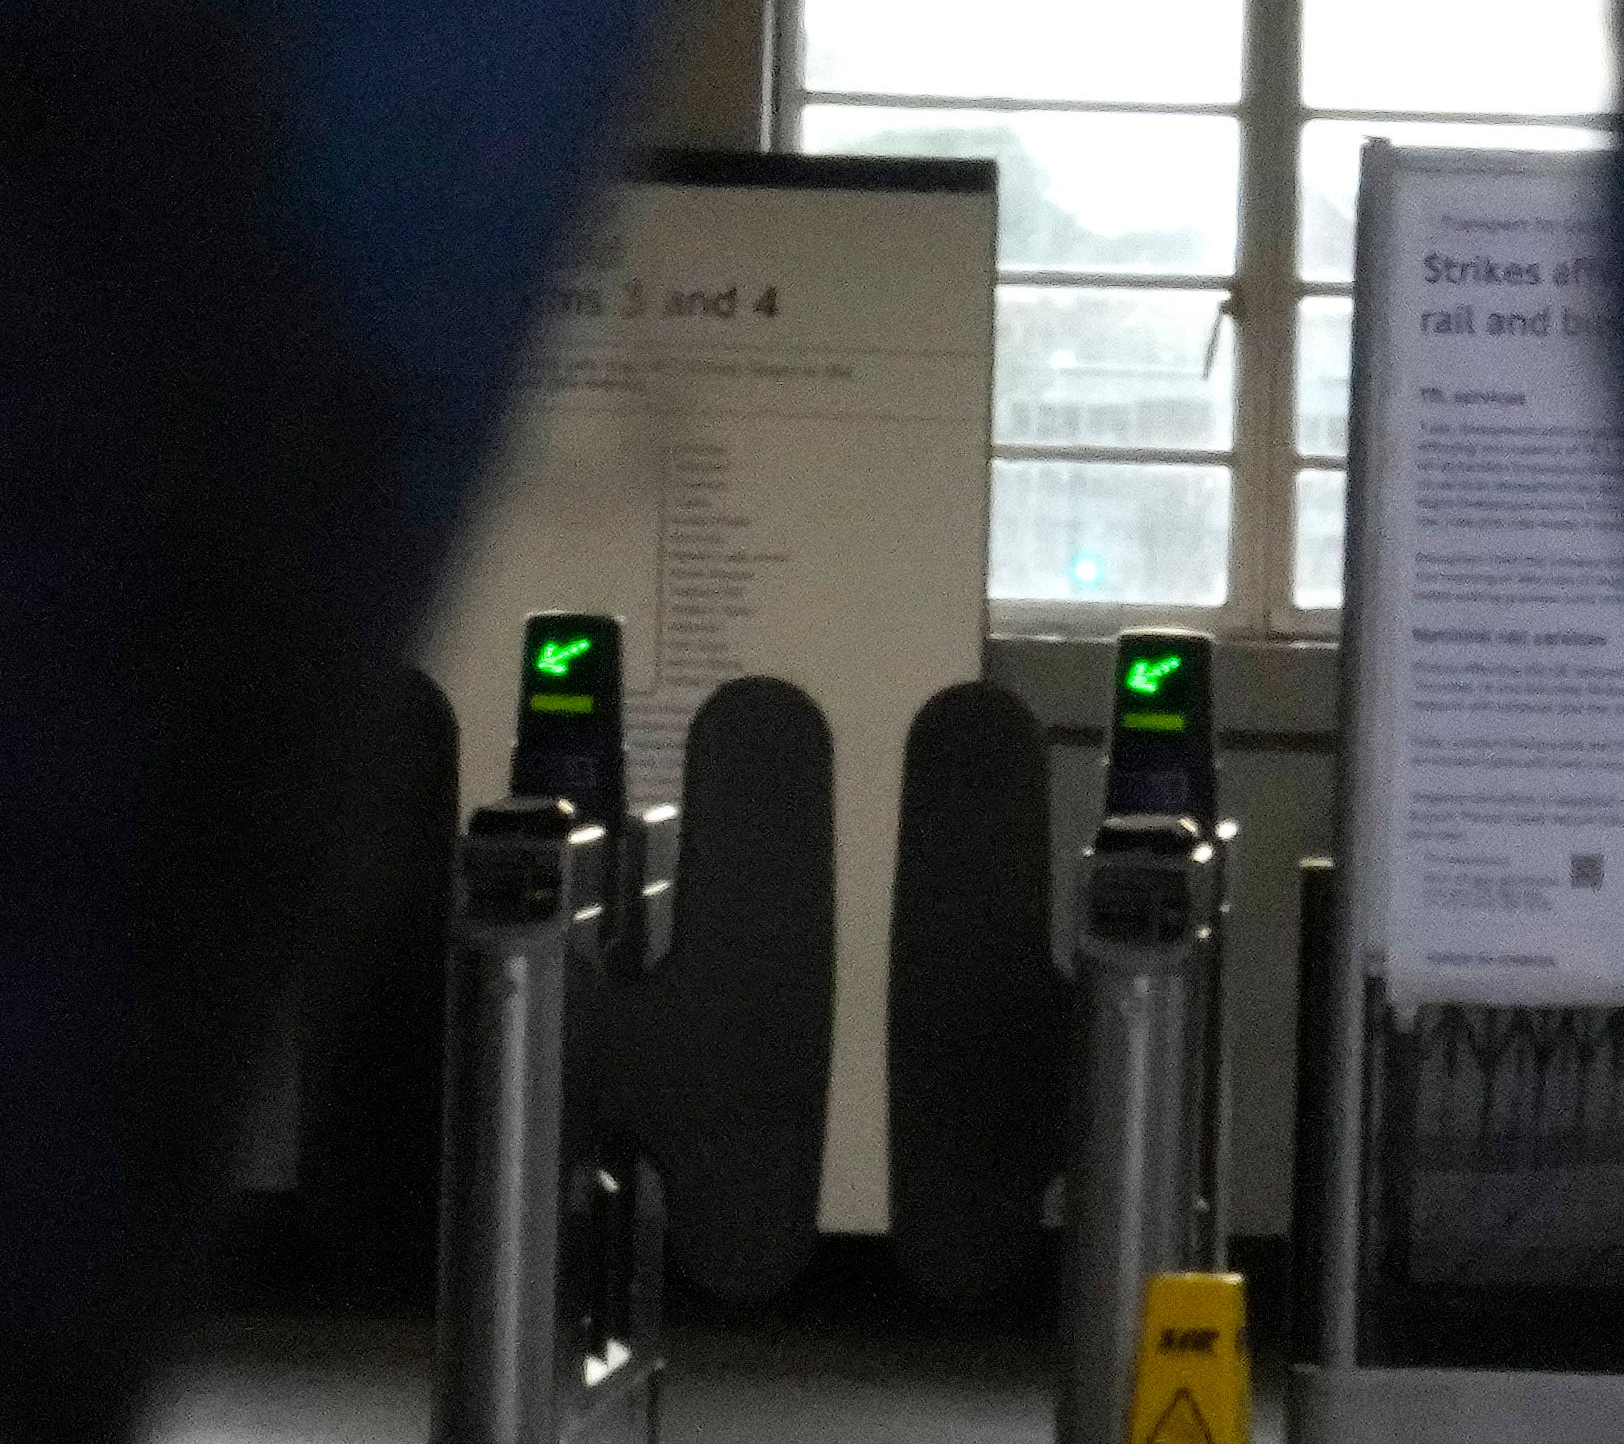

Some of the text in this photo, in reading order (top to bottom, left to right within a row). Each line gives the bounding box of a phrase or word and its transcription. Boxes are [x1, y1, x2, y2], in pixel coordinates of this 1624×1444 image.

[1422, 252, 1542, 285] Strikes
[662, 283, 738, 318] and
[750, 284, 780, 318] 4
[1419, 305, 1474, 336] rail
[1486, 304, 1550, 336] and
